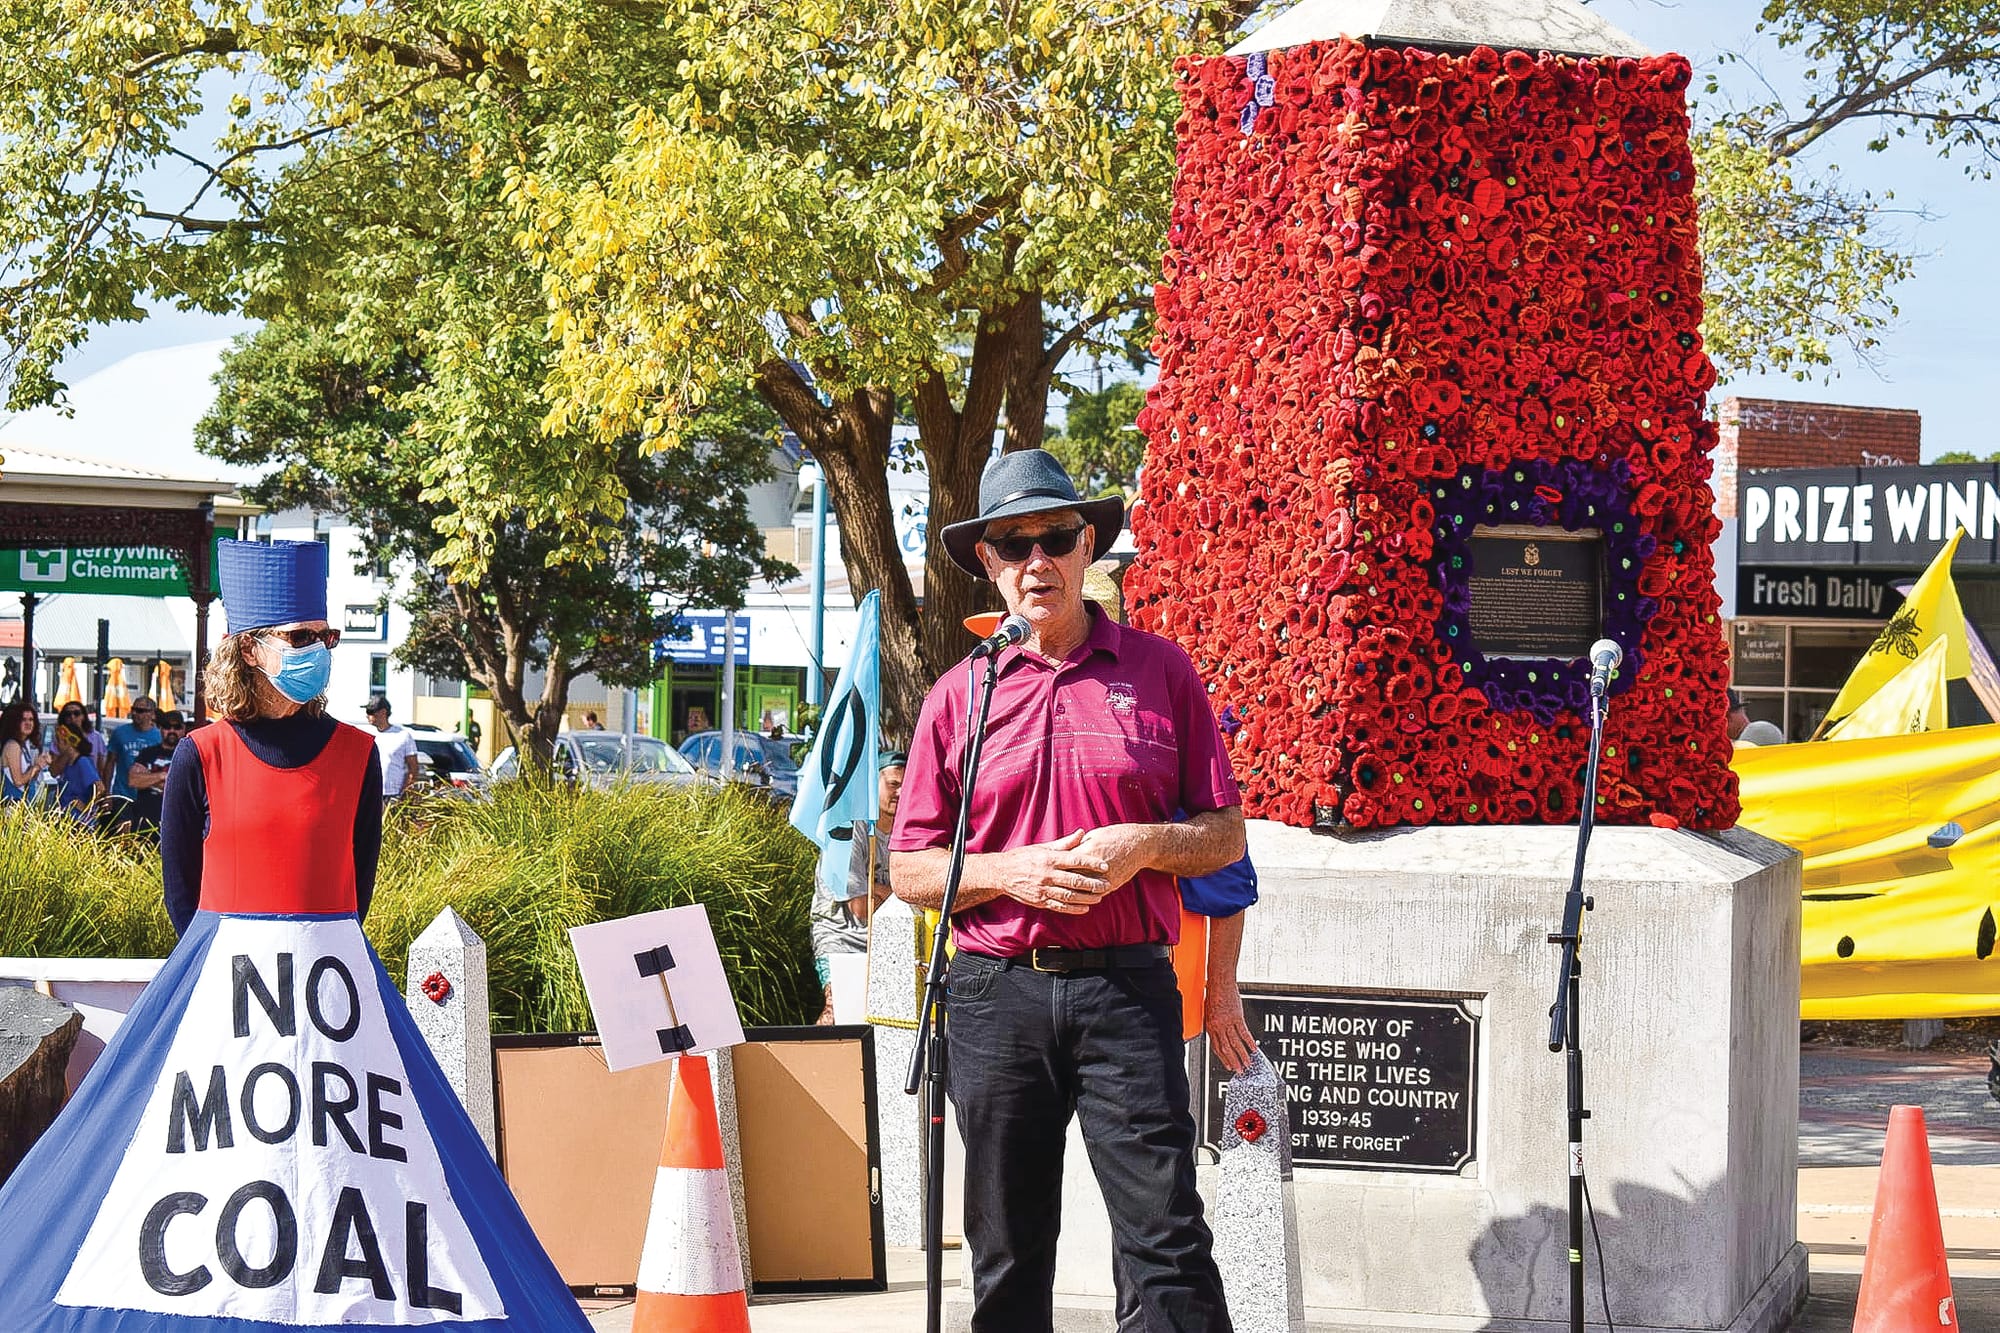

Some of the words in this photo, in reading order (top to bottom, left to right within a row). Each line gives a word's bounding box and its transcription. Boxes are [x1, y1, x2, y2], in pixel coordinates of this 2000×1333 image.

[1745, 484, 1874, 543] PRIZE
[71, 559, 178, 580] Chemmart
[1501, 567, 1519, 576] LEST
[1520, 568, 1532, 576] WE
[1533, 568, 1563, 577] FORGET
[1753, 573, 1817, 606] Fresh
[1827, 576, 1884, 614] Daily
[231, 952, 361, 1042] NO
[1264, 1014, 1284, 1033] IN
[1291, 1015, 1377, 1036] MEMORY
[1386, 1019, 1414, 1037] OF
[1278, 1038, 1347, 1059] THOSE
[1355, 1043, 1401, 1060] WHO
[1273, 1061, 1298, 1079] VE
[1307, 1063, 1367, 1082] THEIR
[1375, 1066, 1431, 1085] LIVES
[1285, 1084, 1312, 1102] NG
[1319, 1086, 1361, 1105] AND
[1368, 1089, 1460, 1110] COUNTRY
[165, 1061, 408, 1163] MORE
[1302, 1109, 1372, 1128] 1939-45
[1291, 1133, 1310, 1147] ST
[1316, 1134, 1339, 1148] WE
[139, 1180, 463, 1316] COAL
